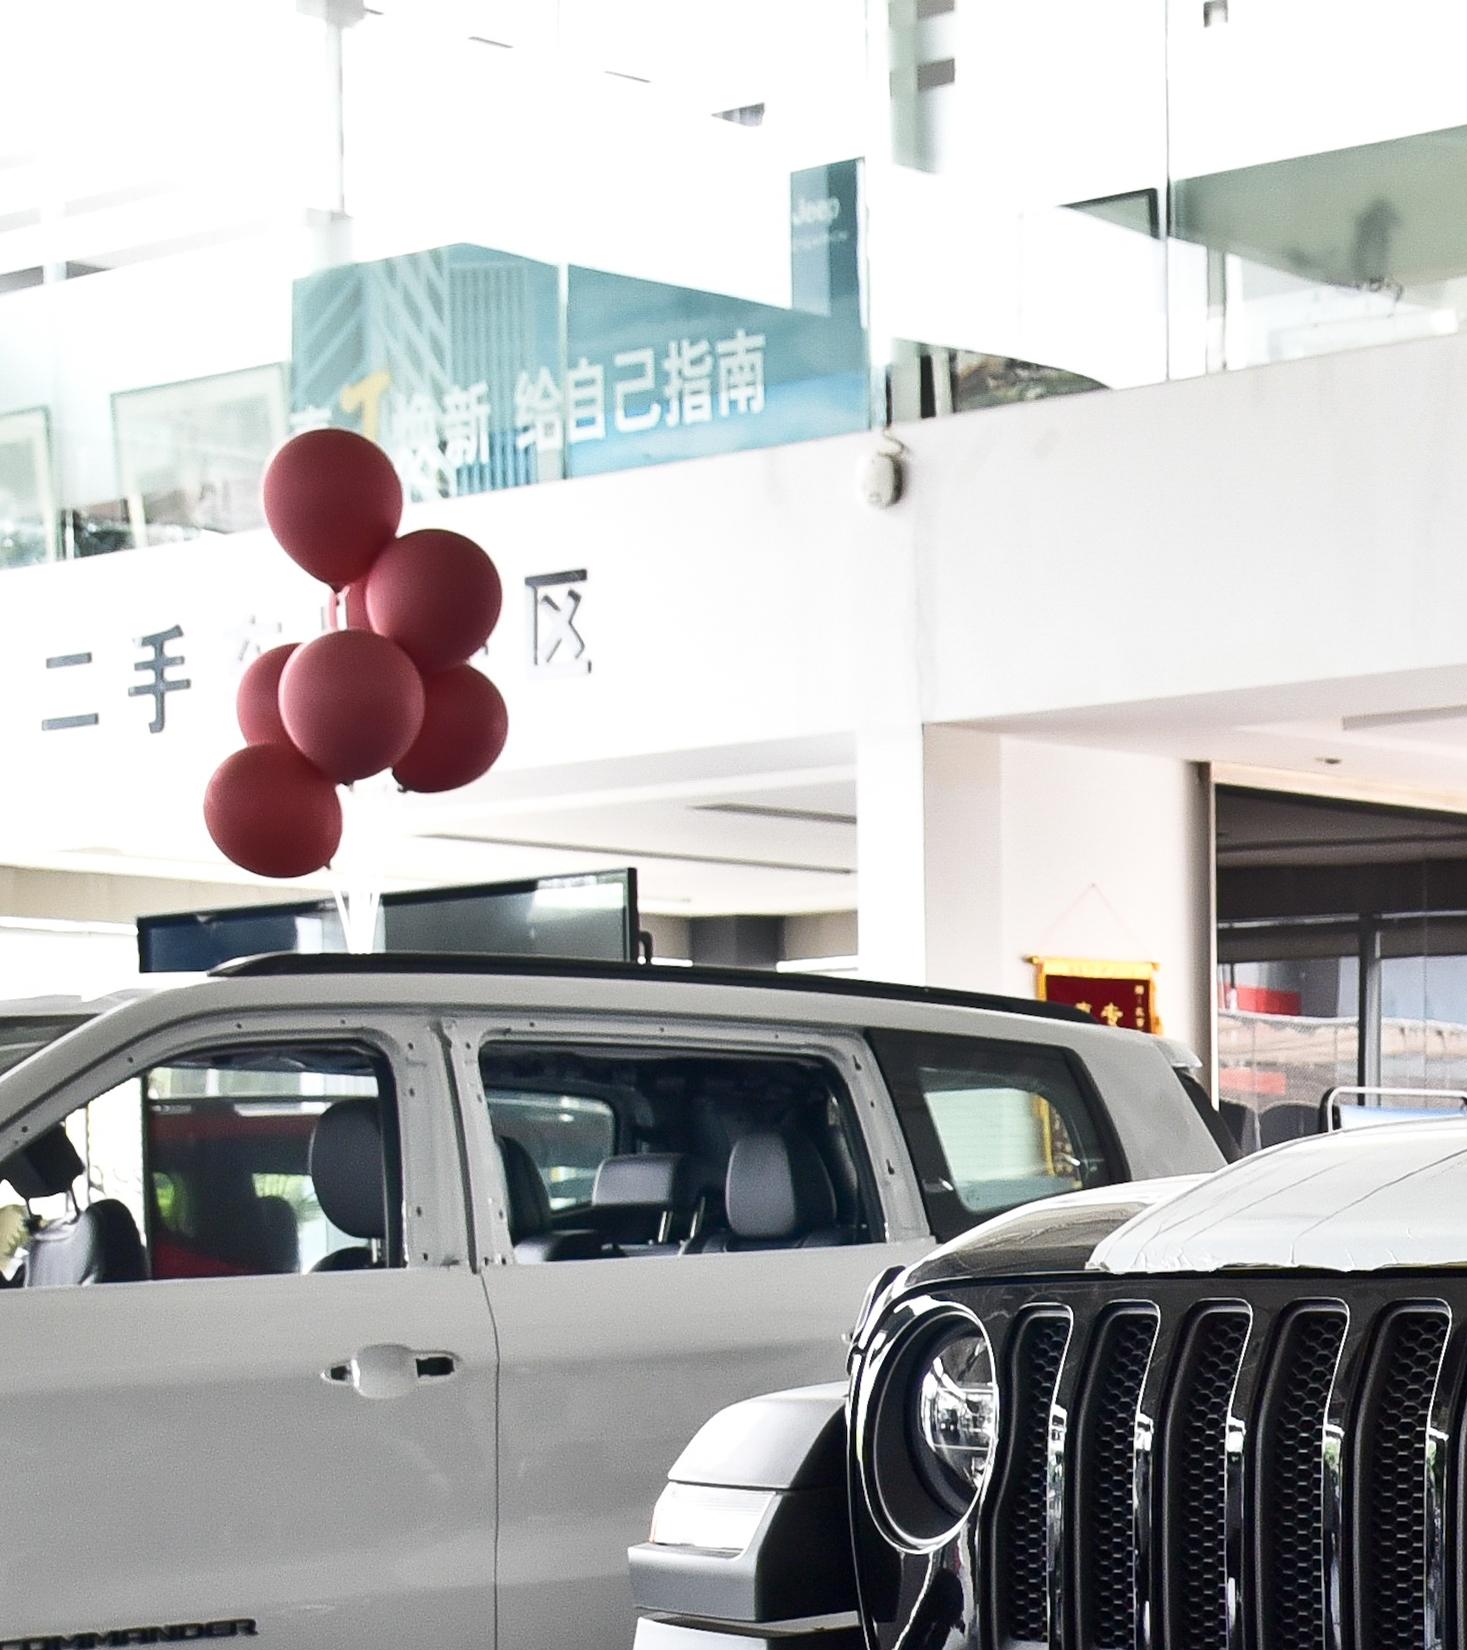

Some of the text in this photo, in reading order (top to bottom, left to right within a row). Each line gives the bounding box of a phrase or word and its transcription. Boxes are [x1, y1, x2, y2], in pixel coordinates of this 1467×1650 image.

[514, 329, 767, 451] 给自己指南
